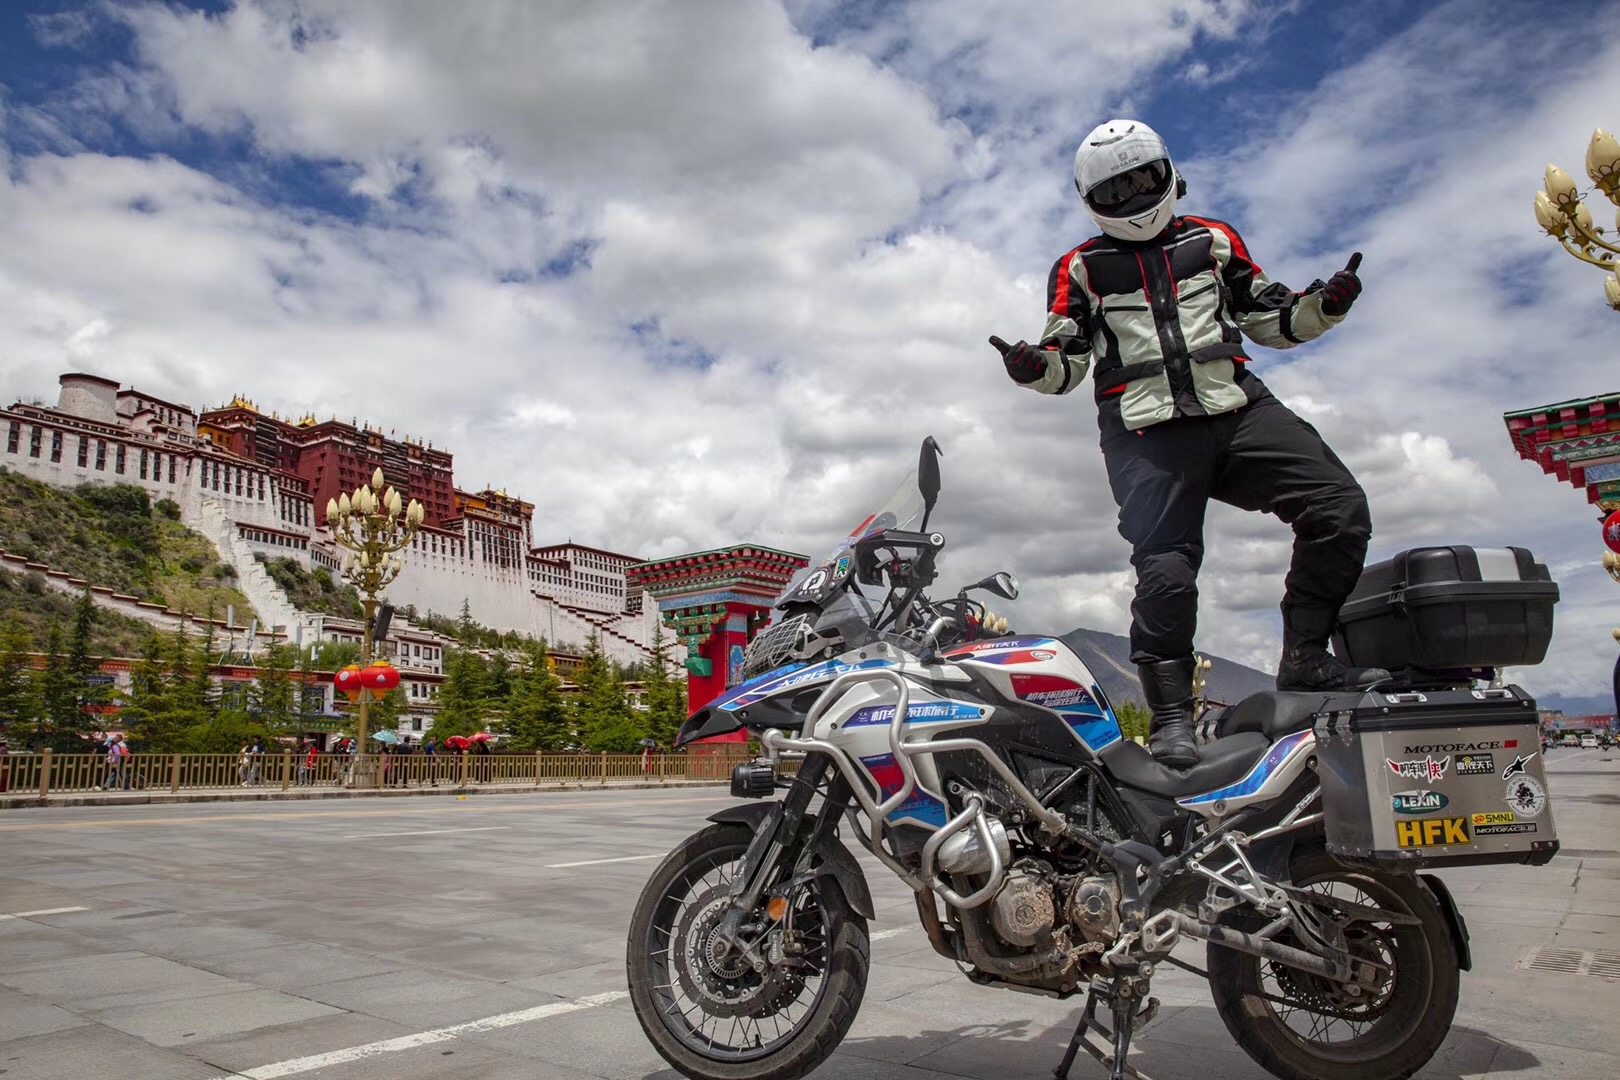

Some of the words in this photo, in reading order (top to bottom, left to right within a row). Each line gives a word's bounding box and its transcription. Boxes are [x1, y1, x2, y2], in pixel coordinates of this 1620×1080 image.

[1404, 741, 1500, 754] MOTOFACE
[1401, 794, 1440, 808] LEXIN
[1486, 813, 1514, 823] SMNU
[1397, 818, 1469, 847] HFK
